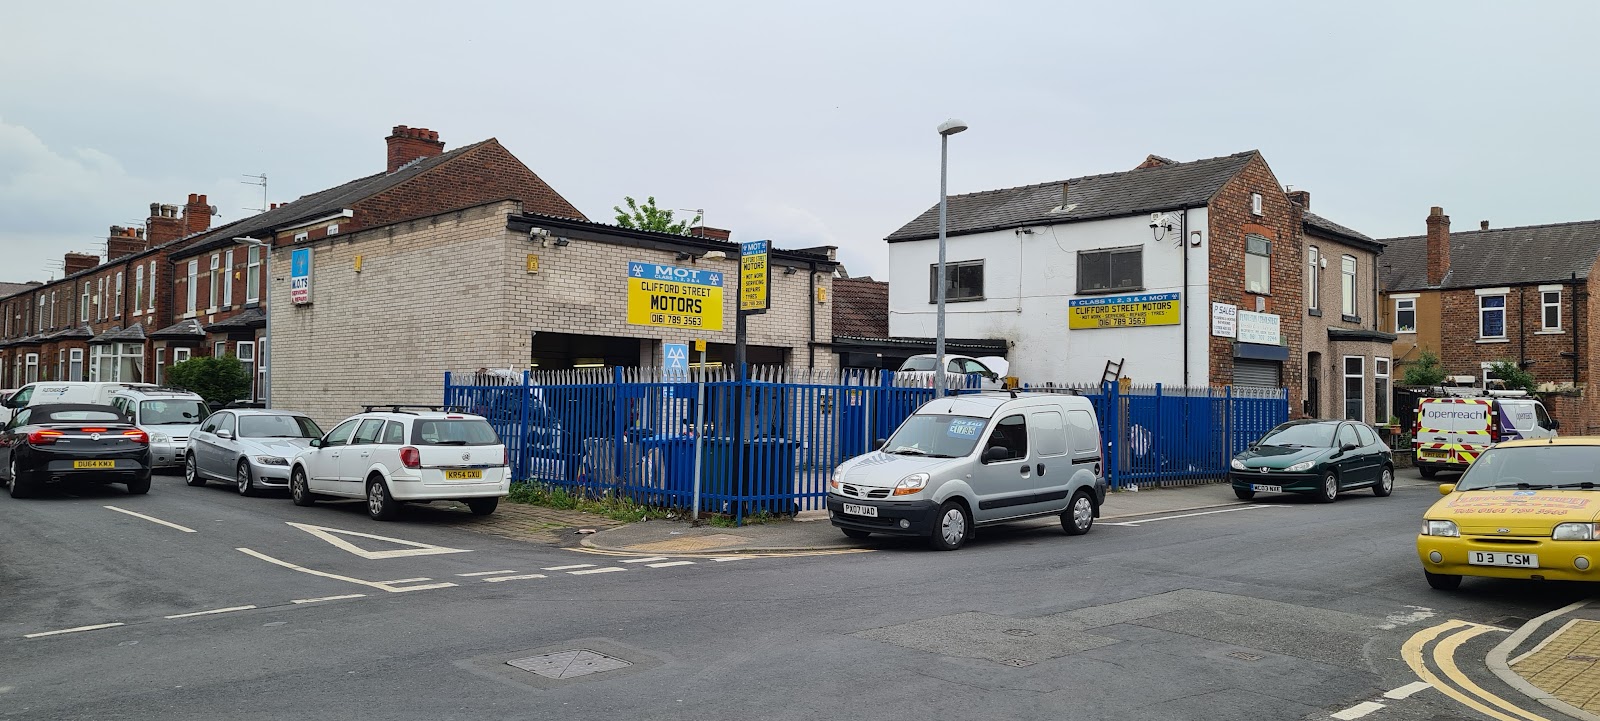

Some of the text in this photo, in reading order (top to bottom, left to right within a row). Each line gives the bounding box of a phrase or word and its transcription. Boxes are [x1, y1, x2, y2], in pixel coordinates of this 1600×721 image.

[748, 242, 761, 250] MOT
[744, 262, 764, 270] MOTORS
[655, 266, 700, 279] MOT
[641, 282, 711, 297] CLIFFORD STREET
[650, 294, 702, 313] MOTORS
[1076, 302, 1172, 315] CLIFFORD STREET MOTORS
[1214, 305, 1235, 316] P SALES
[668, 316, 681, 324] 789
[684, 317, 701, 326] 3563
[1428, 410, 1482, 420] openreach
[1516, 412, 1533, 421] openreach
[846, 505, 874, 515] PX07 UAD
[1506, 554, 1530, 565] CSM
